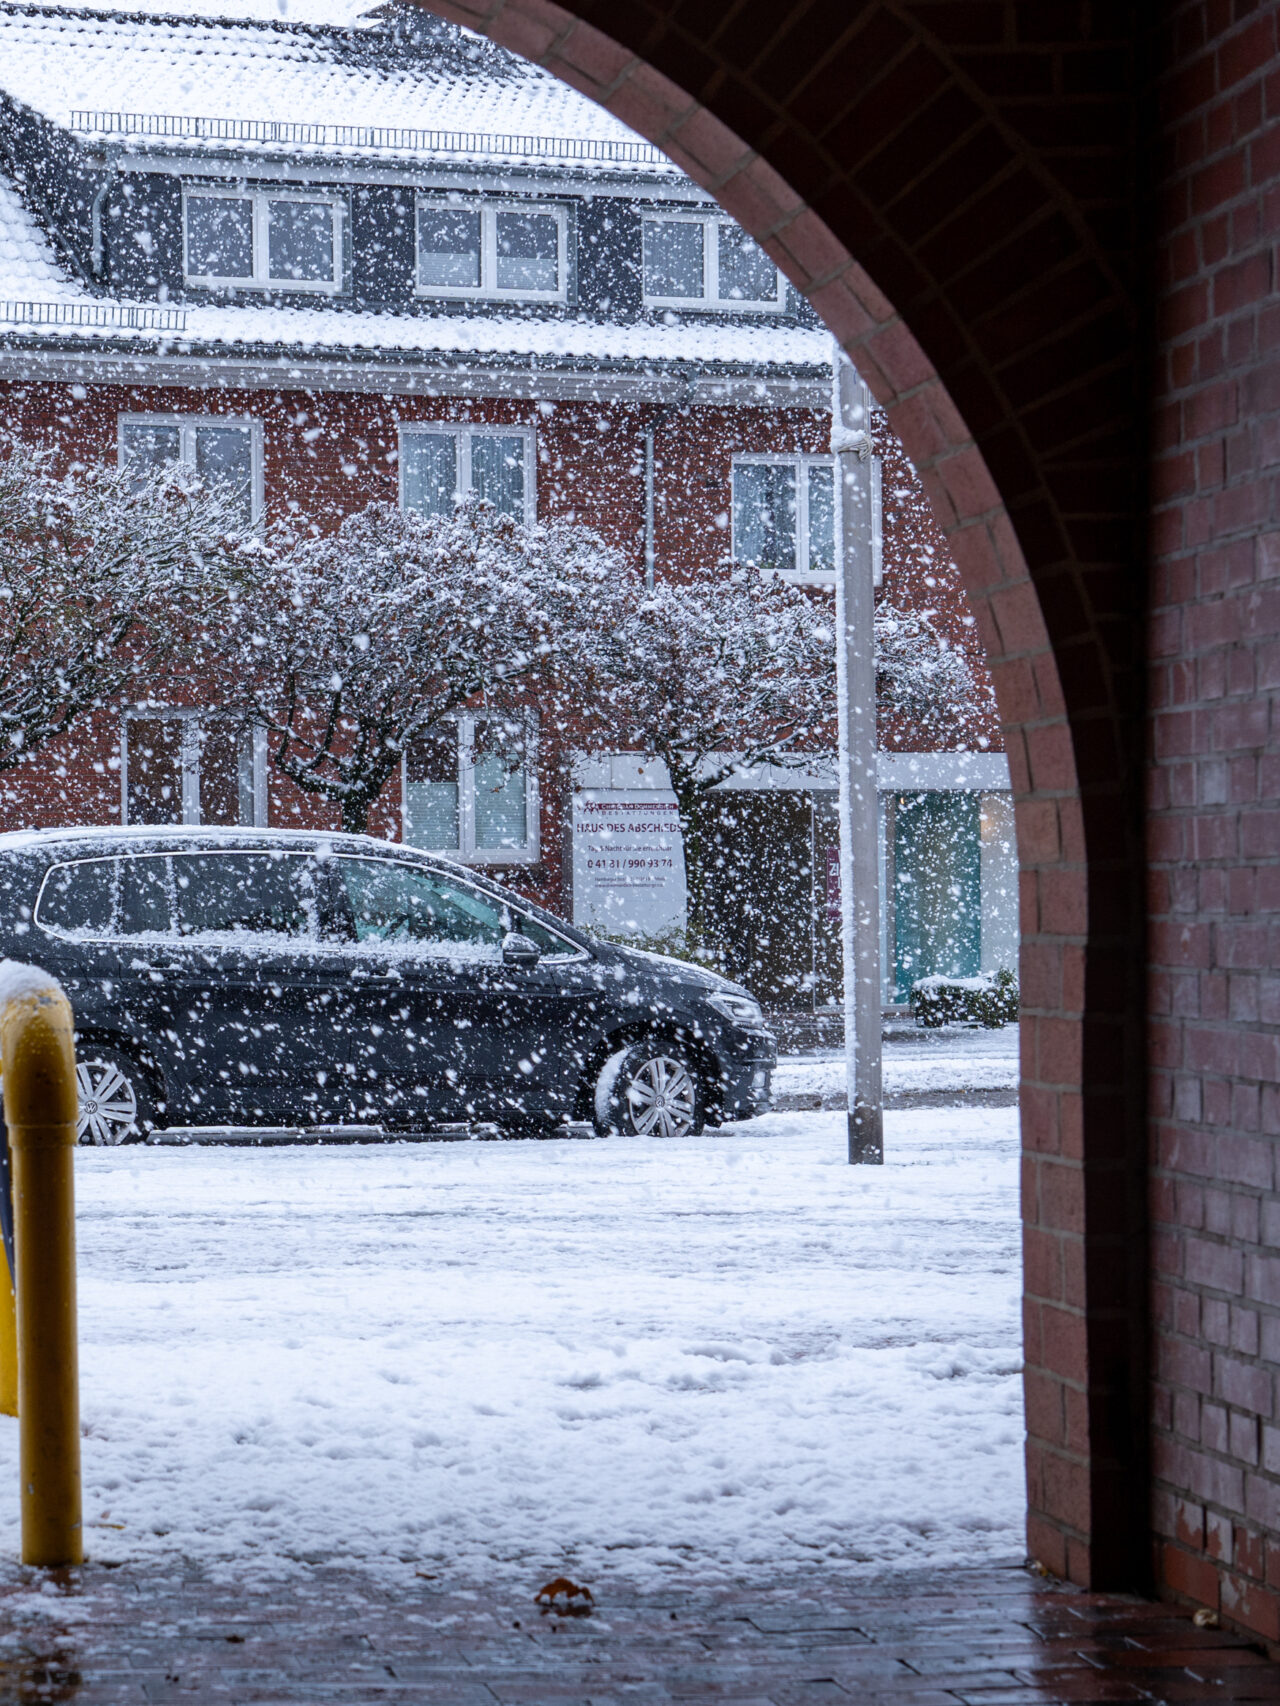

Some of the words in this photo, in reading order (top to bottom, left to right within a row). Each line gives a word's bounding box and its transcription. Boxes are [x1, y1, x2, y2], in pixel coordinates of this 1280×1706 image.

[577, 823, 604, 832] HAUS
[606, 823, 625, 832] DES
[595, 859, 606, 868] 41
[628, 859, 645, 868] 990
